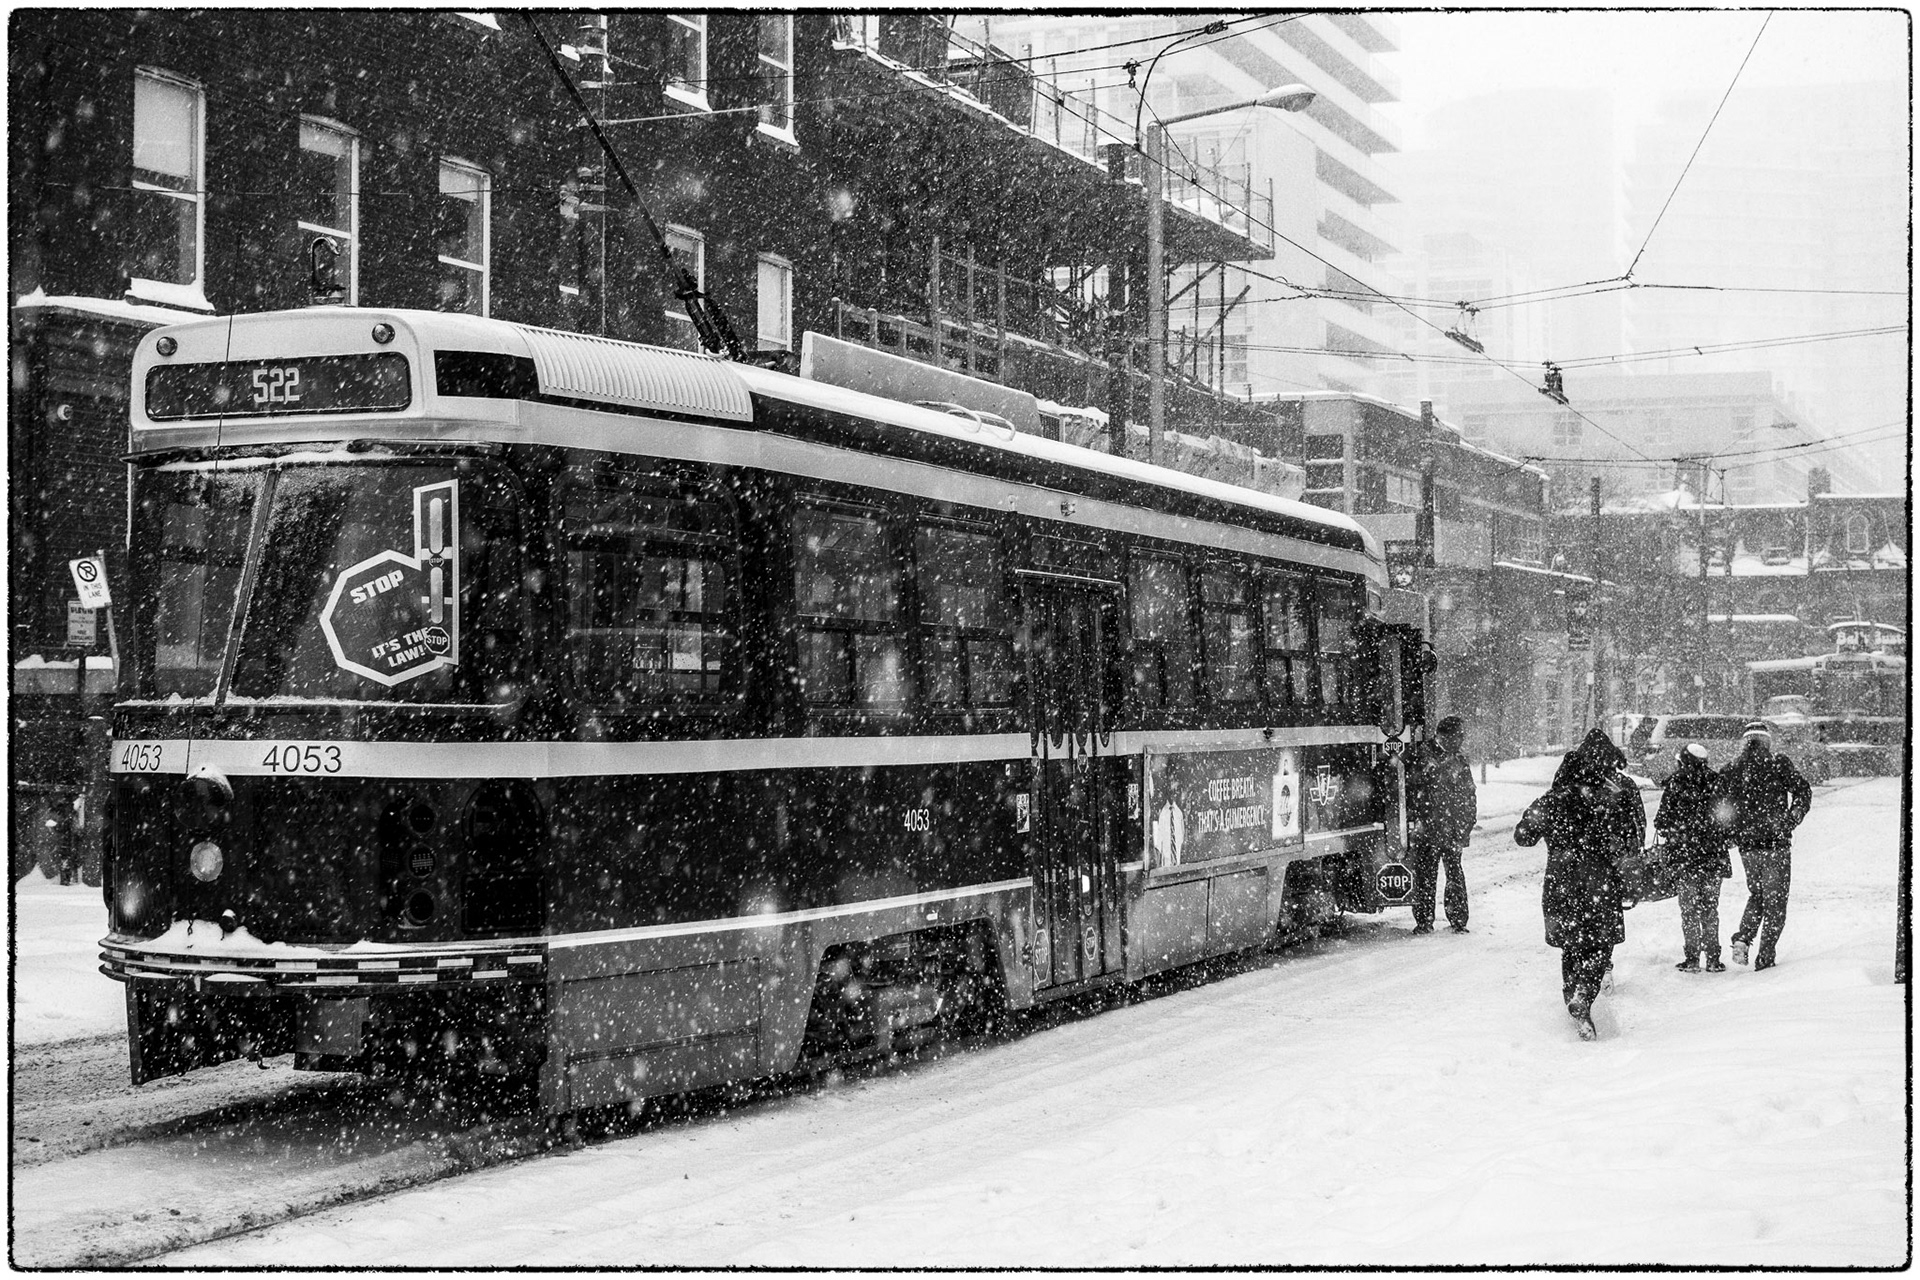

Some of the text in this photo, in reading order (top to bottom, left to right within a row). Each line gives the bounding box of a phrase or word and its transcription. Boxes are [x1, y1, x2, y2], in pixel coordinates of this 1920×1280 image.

[253, 367, 300, 402] 522
[88, 590, 102, 598] LANE
[350, 570, 404, 604] STOP
[371, 638, 401, 659] IT'S
[427, 635, 447, 646] STOP
[387, 645, 426, 667] LAW!
[1385, 742, 1402, 750] STOP
[122, 744, 163, 771] 4053
[262, 745, 342, 773] 4053
[1208, 779, 1230, 801] COFFEE
[904, 808, 930, 832] 4053
[1380, 875, 1408, 888] STOP
